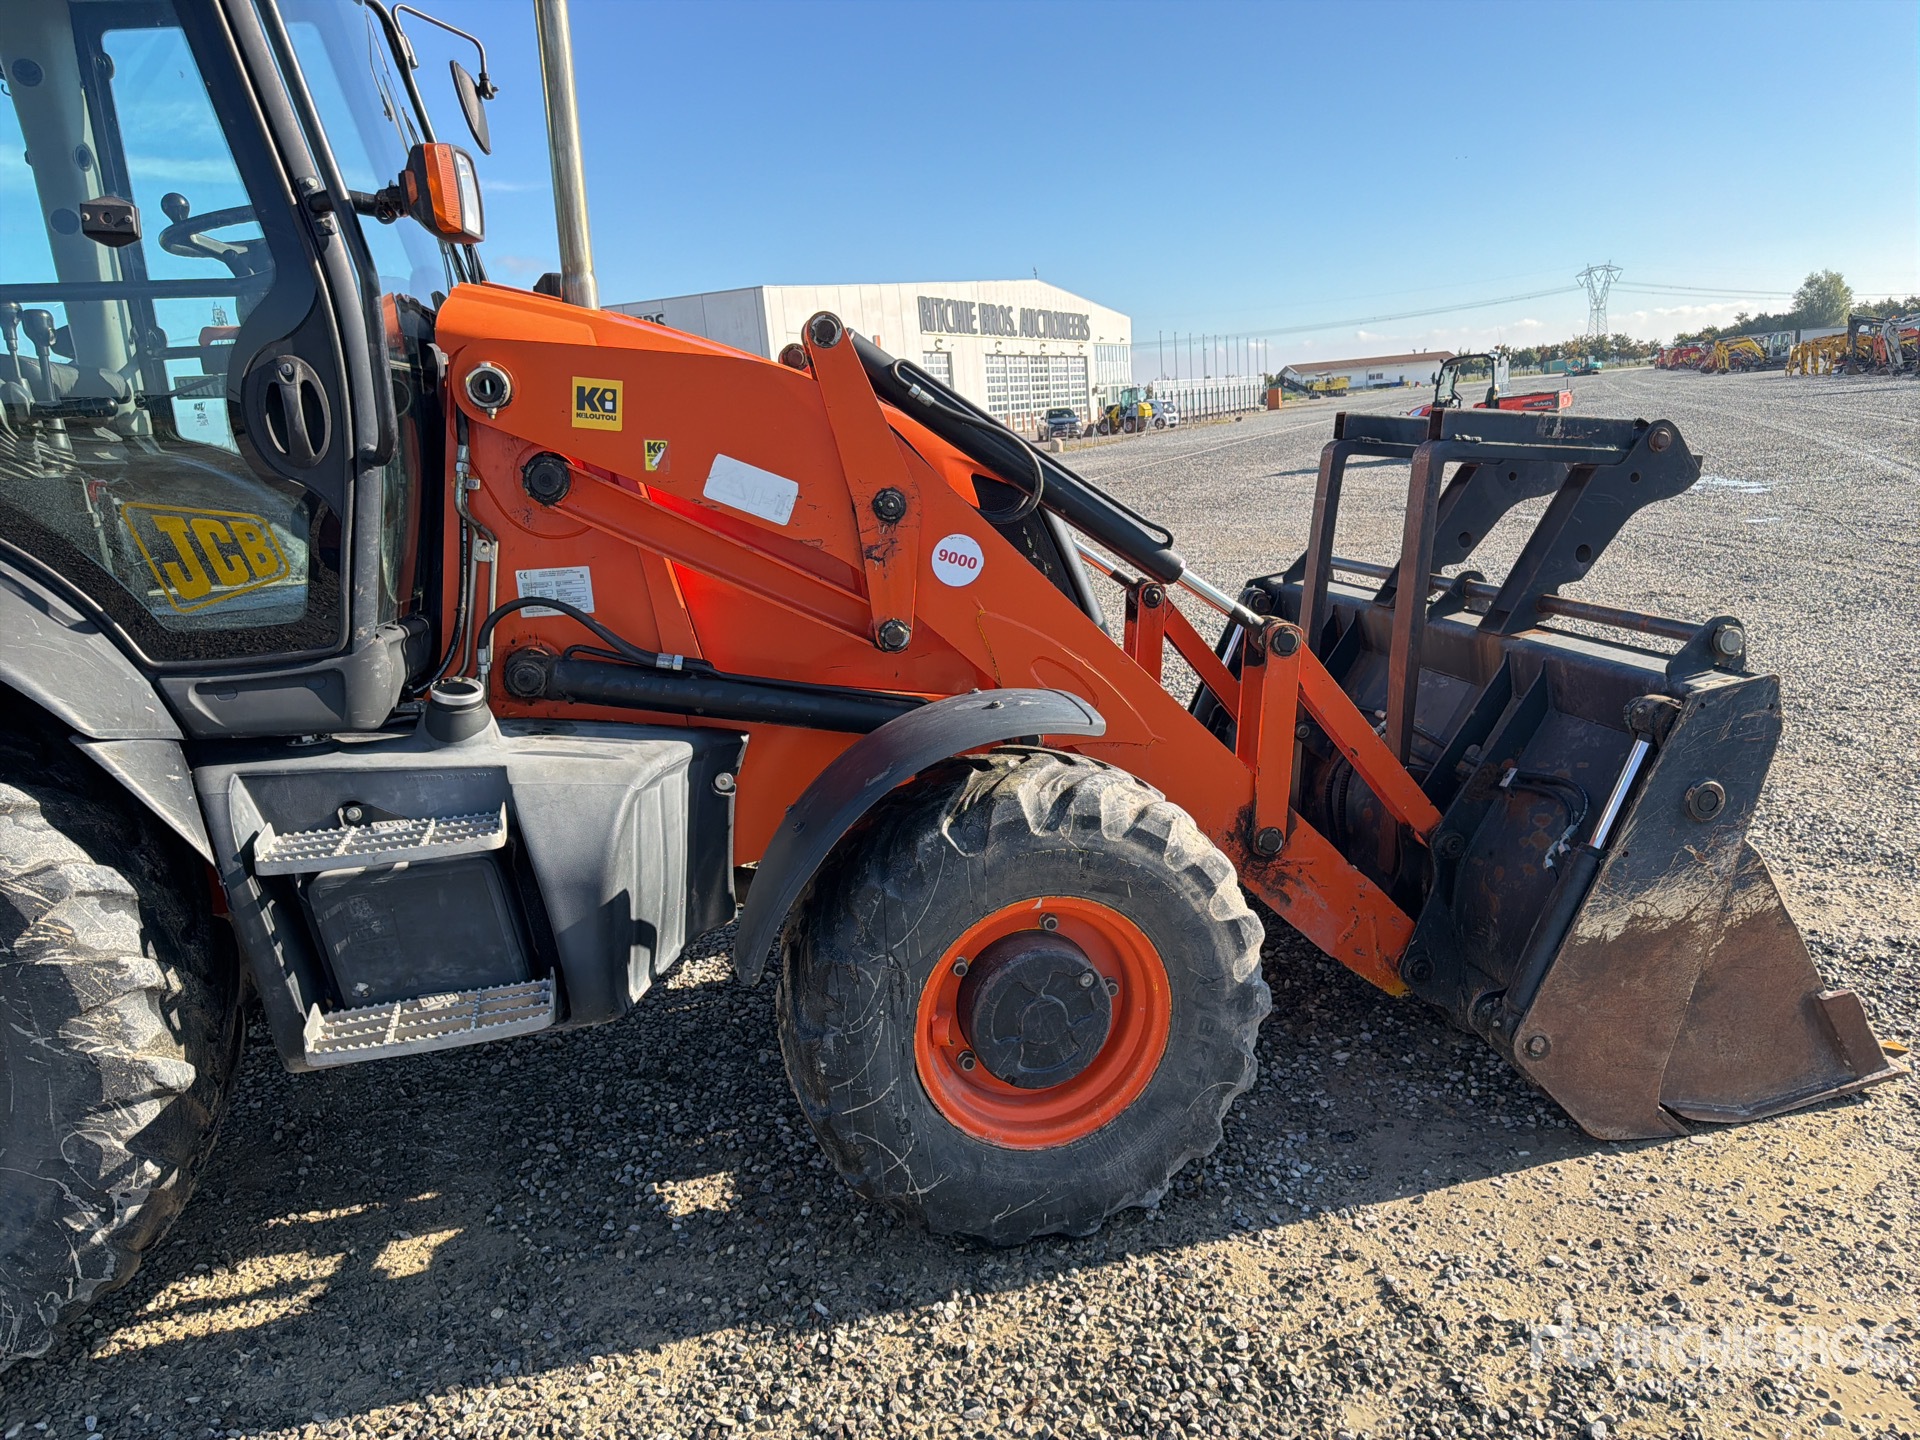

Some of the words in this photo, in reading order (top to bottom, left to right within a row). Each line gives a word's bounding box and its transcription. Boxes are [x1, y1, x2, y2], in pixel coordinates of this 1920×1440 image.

[917, 296, 978, 335] RITCHIE
[978, 302, 1018, 337] BROS.
[1019, 307, 1091, 341] AUCTIONEERS
[152, 515, 279, 600] JCB
[938, 548, 978, 570] 9000
